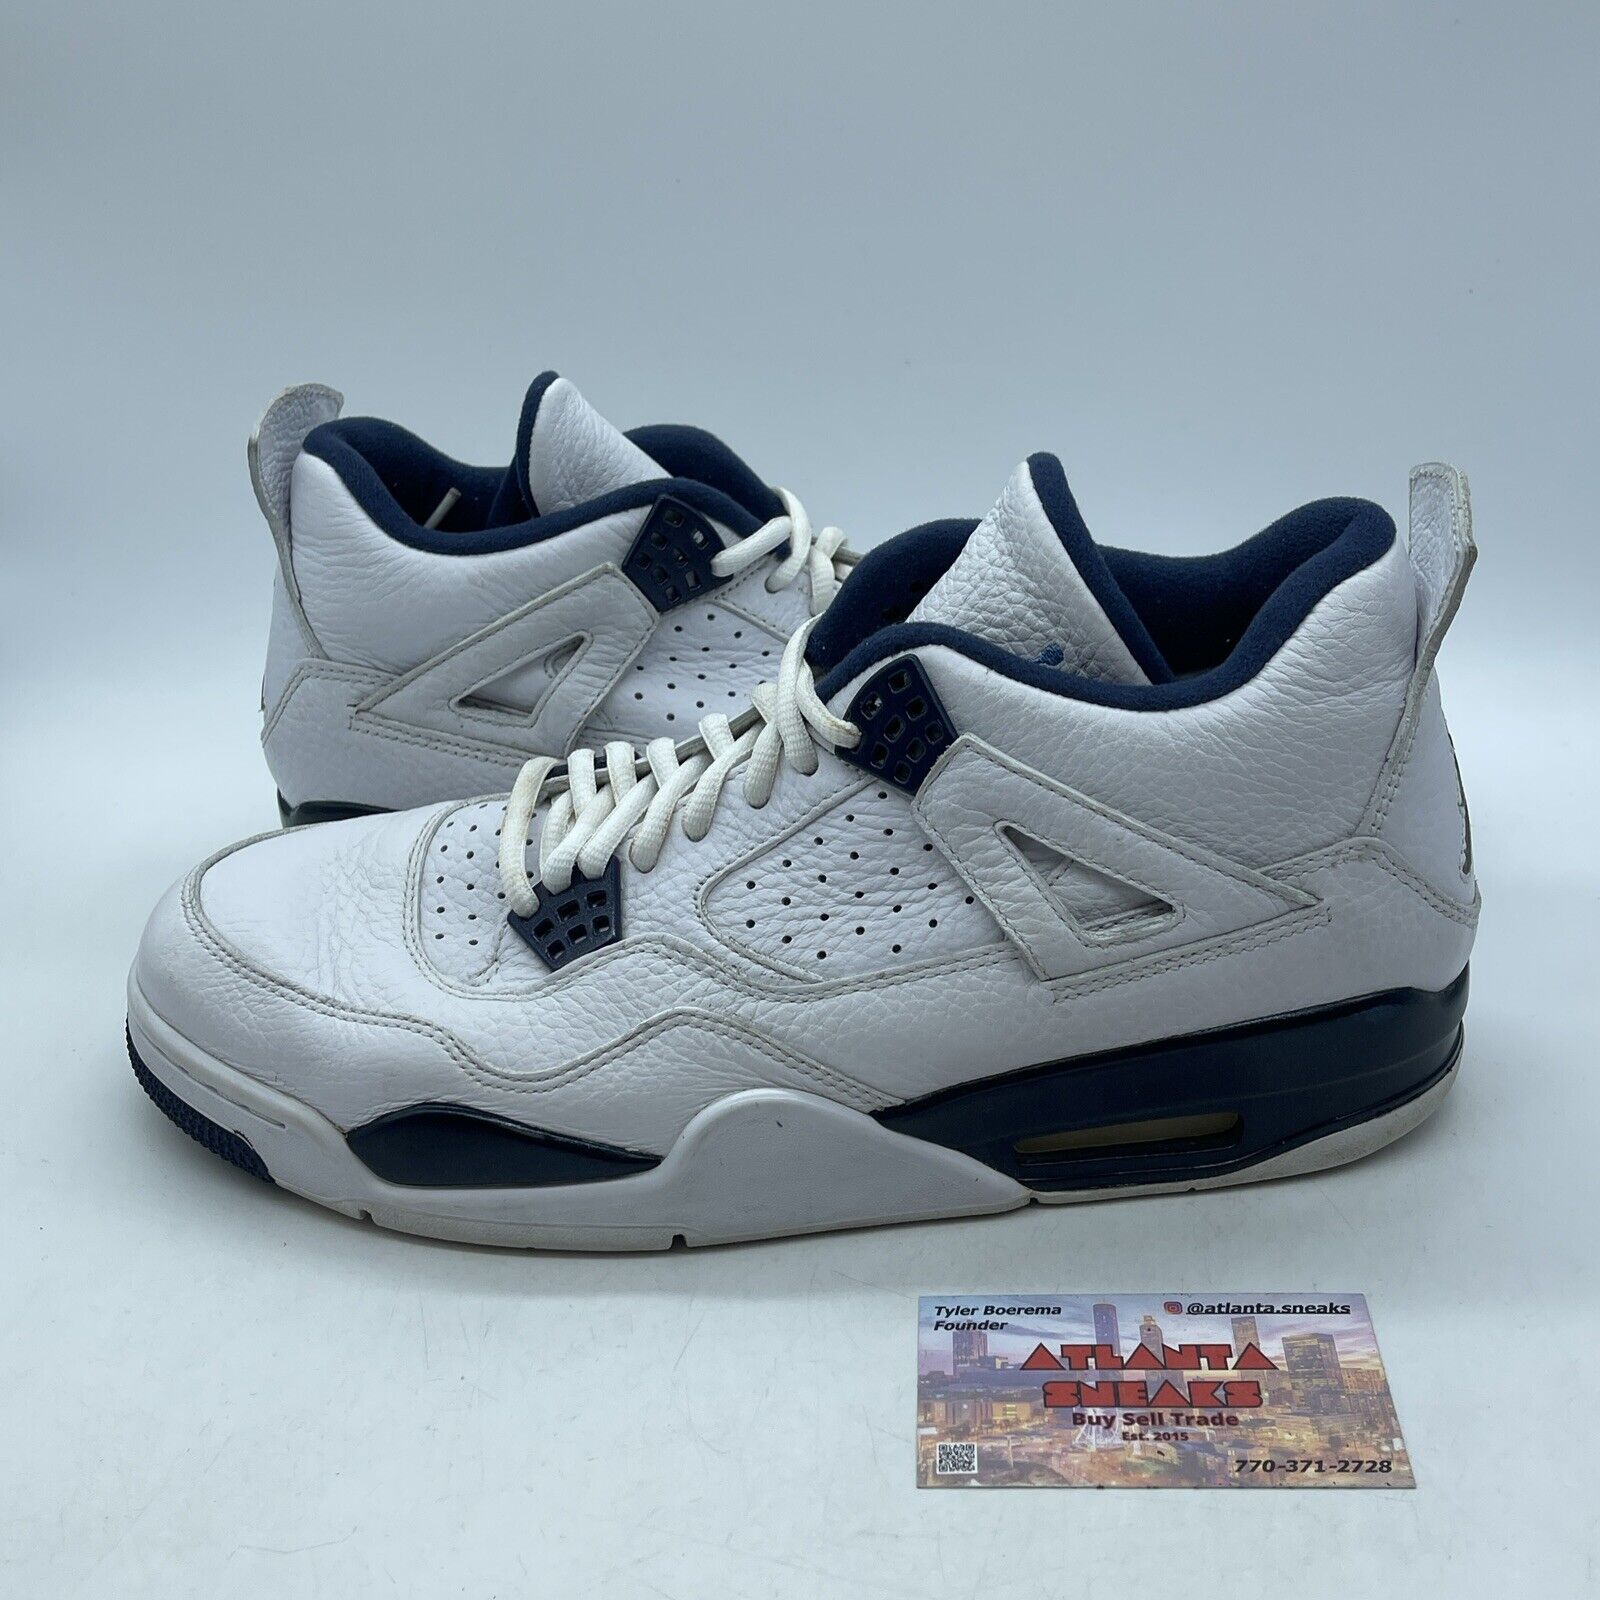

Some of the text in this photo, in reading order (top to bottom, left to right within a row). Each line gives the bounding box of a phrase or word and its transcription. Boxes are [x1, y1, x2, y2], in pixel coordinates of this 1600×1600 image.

[934, 1305, 1062, 1318] Tyler Boerema
[1186, 1302, 1351, 1315] @atlanta.sneaks
[933, 1320, 1008, 1331] Founder
[1020, 1342, 1279, 1370] ATLANTA
[1042, 1379, 1264, 1408] SNEAKS
[1072, 1412, 1239, 1429] Buy Sell Trade
[1122, 1431, 1189, 1441] Est. 2015
[1235, 1460, 1393, 1473] 770-371-2728
